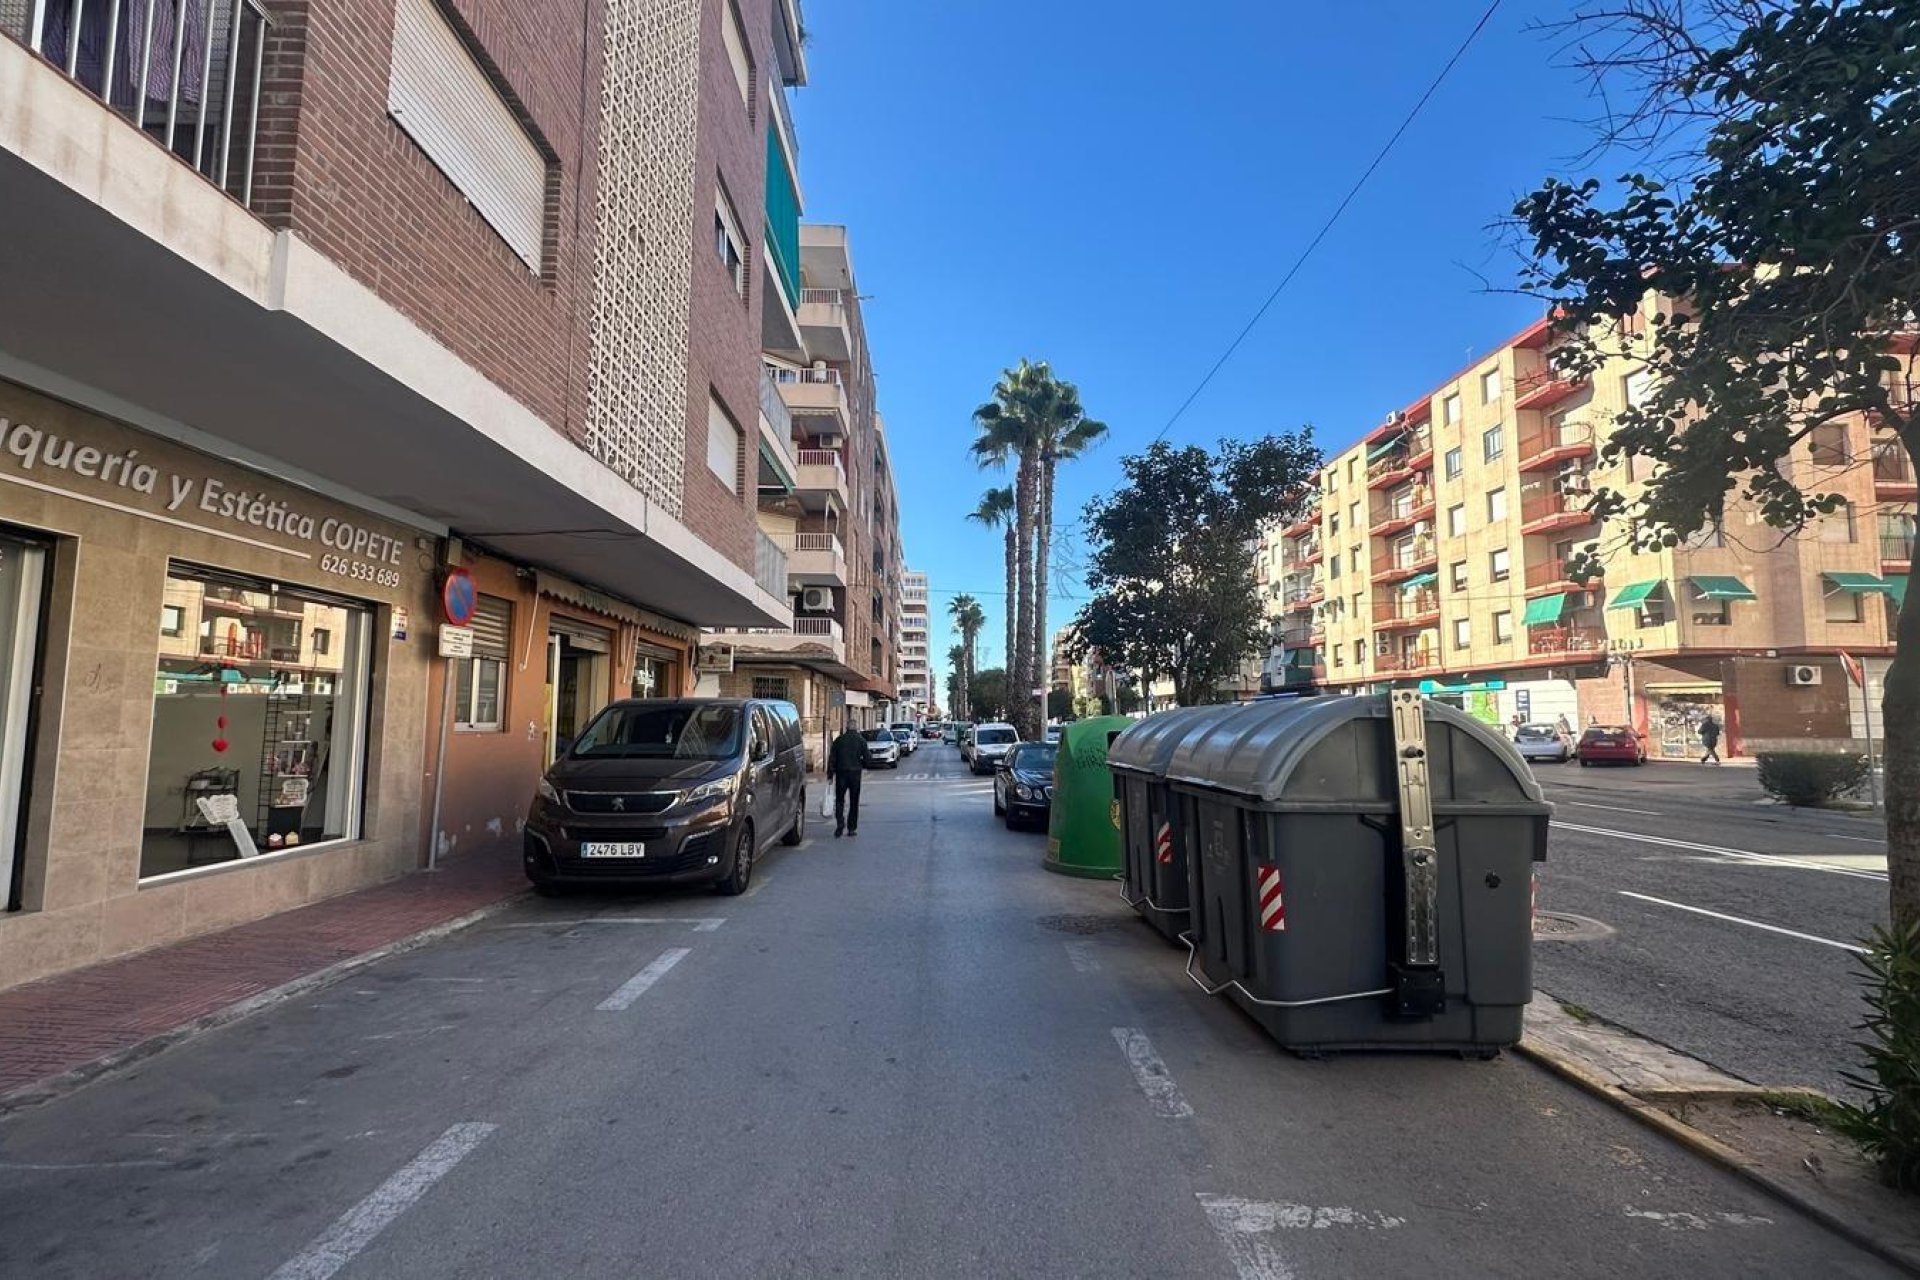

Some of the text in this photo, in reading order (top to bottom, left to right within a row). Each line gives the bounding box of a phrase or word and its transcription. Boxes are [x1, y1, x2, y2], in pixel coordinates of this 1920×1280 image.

[167, 475, 193, 511] y
[200, 478, 314, 540] Estética
[320, 518, 404, 566] COPETE
[321, 553, 400, 588] 626 533 689
[590, 844, 642, 856] 2476 LBV
